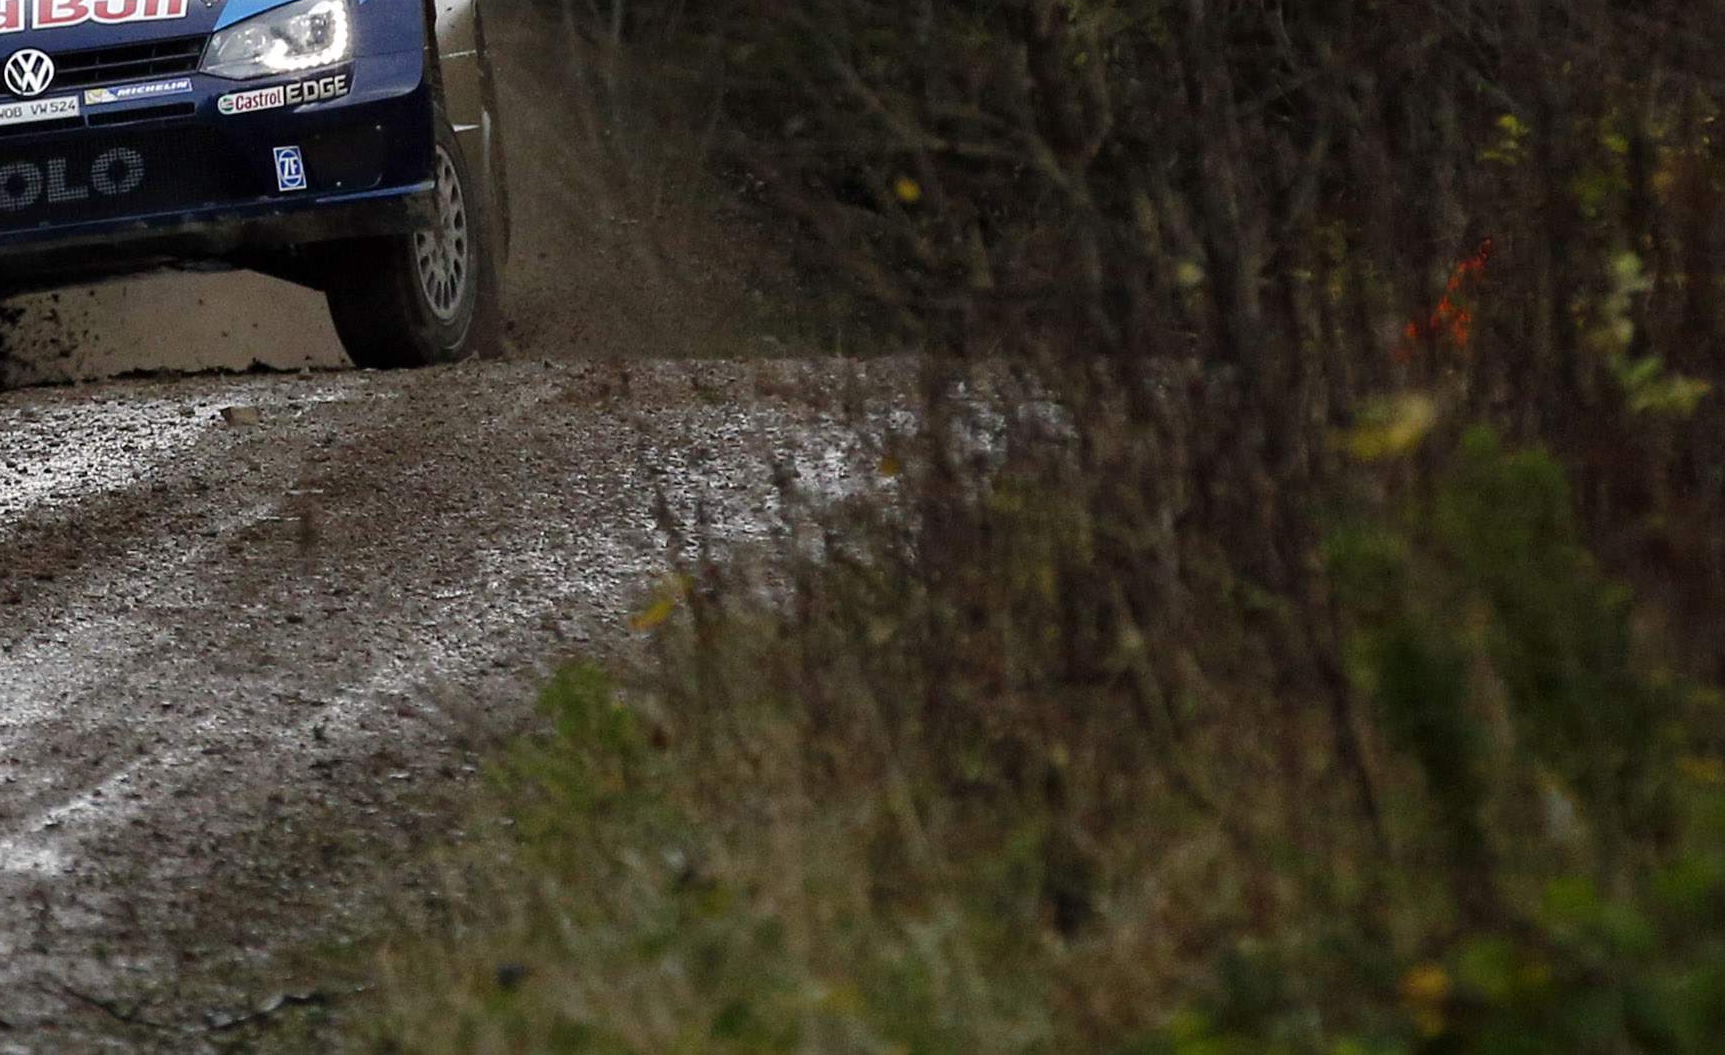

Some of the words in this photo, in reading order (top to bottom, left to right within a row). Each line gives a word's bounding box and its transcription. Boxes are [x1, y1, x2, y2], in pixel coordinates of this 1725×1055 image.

[117, 81, 188, 96] MICHELIN
[235, 89, 282, 110] Castrol
[286, 74, 348, 105] EDGE
[279, 156, 301, 179] ZF
